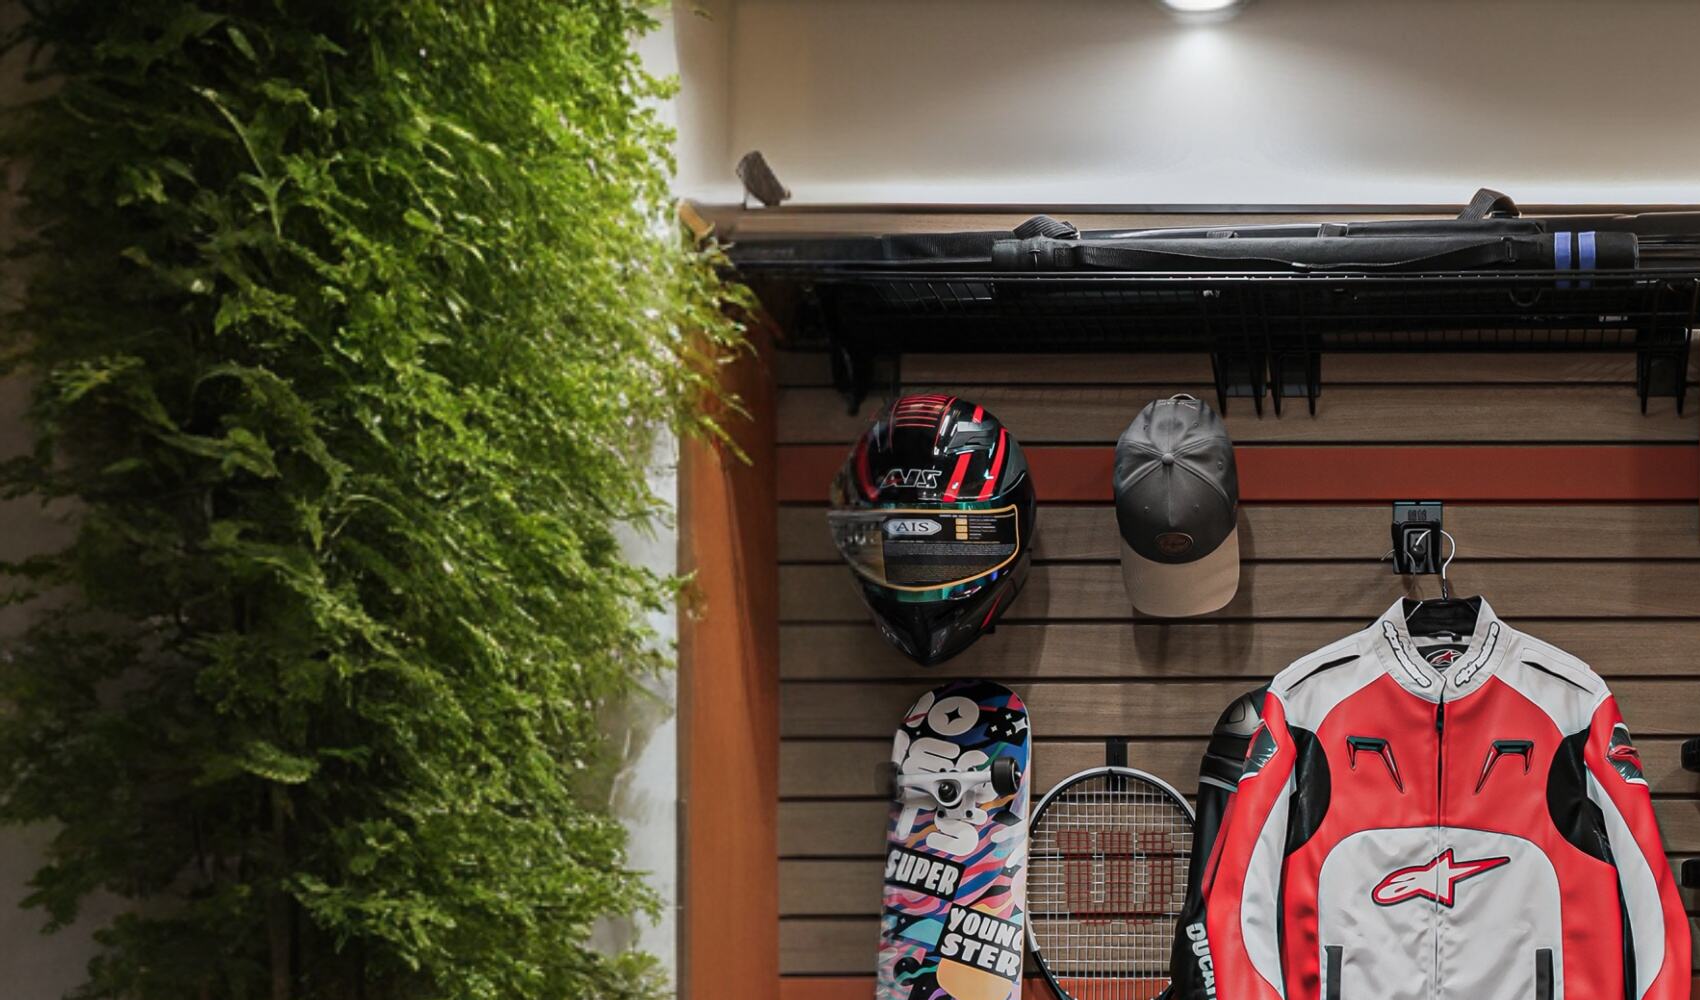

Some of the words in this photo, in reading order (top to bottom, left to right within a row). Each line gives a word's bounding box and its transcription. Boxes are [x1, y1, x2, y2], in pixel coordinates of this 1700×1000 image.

[895, 521, 930, 533] AIS
[885, 849, 960, 896] SUPER
[940, 932, 1021, 977] STER
